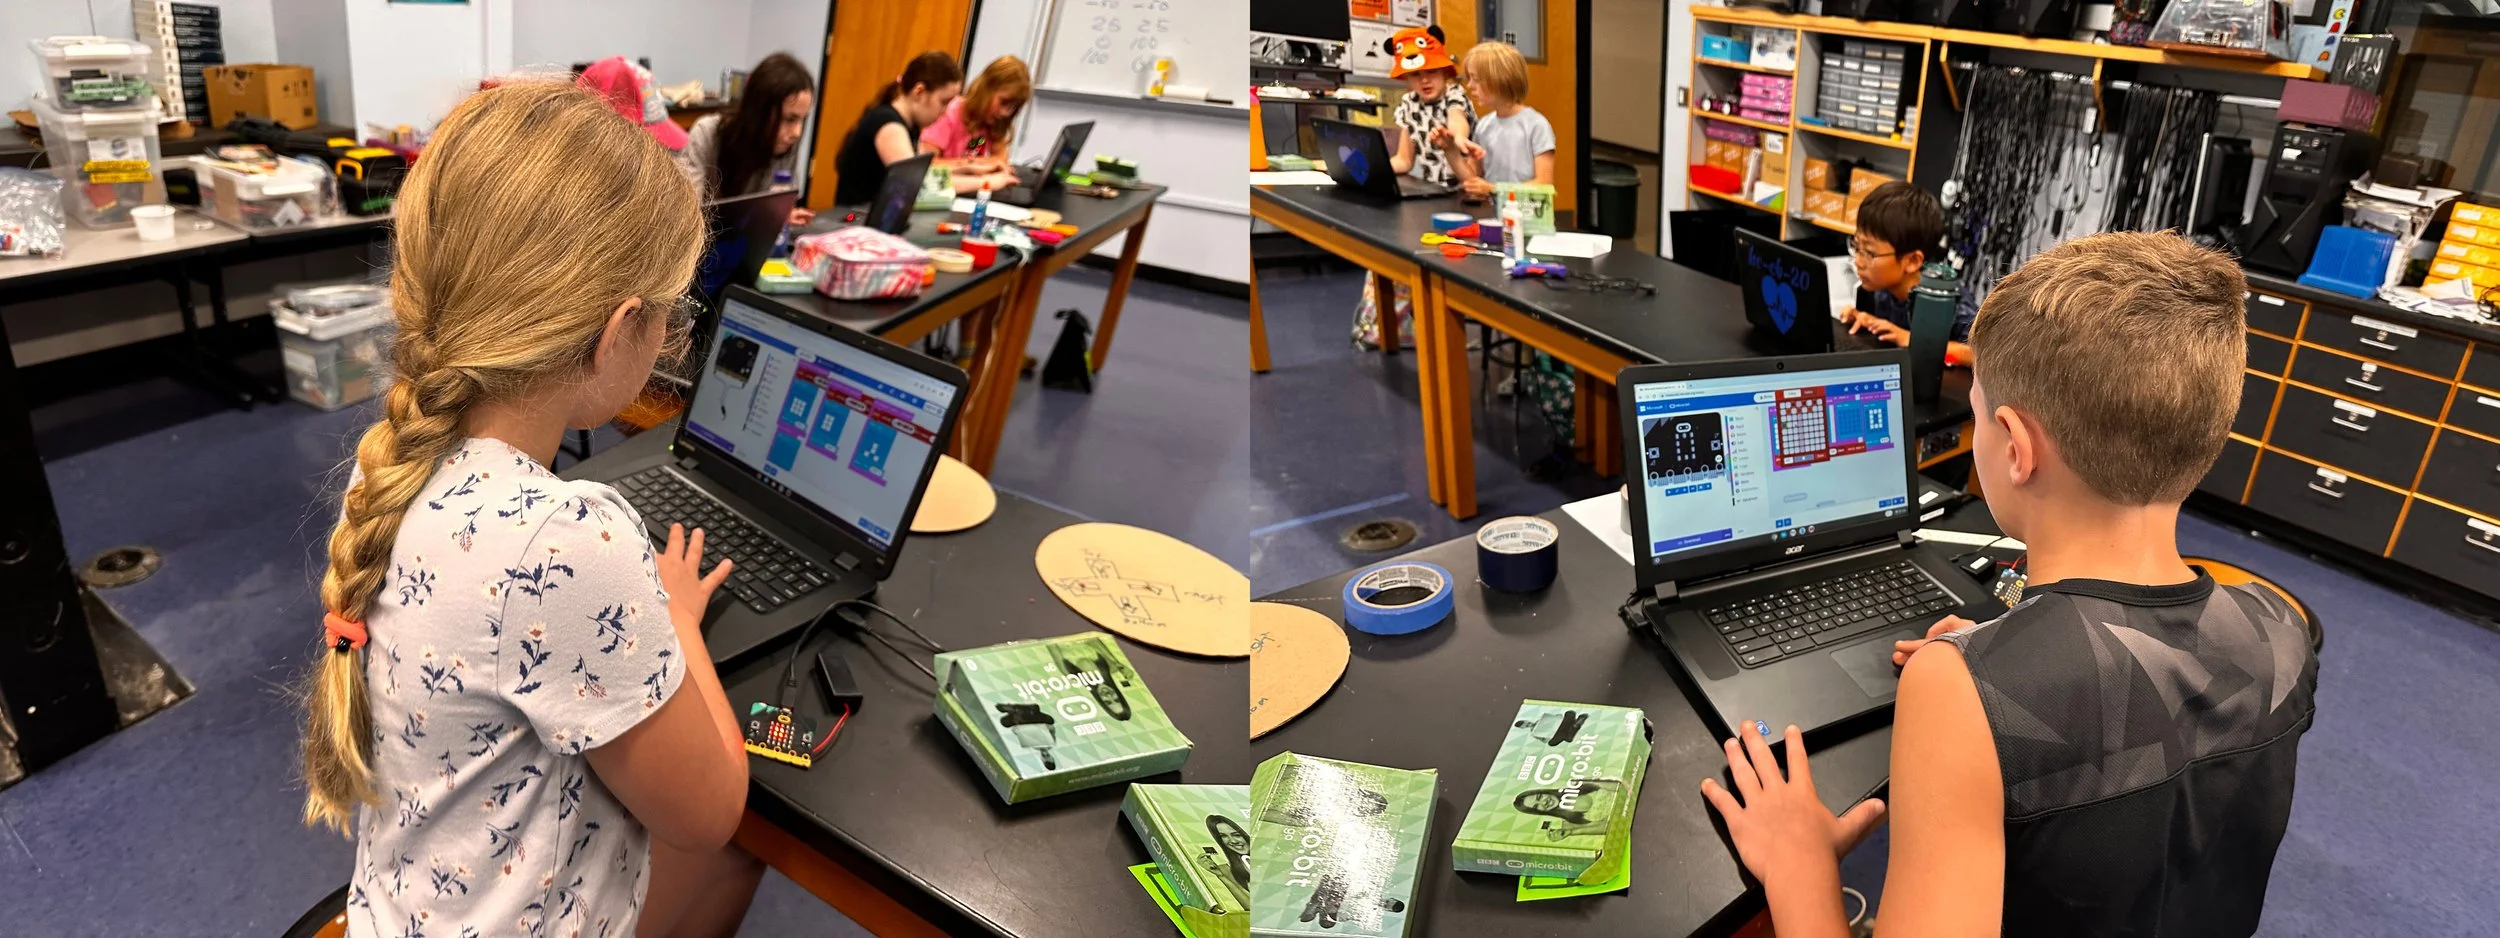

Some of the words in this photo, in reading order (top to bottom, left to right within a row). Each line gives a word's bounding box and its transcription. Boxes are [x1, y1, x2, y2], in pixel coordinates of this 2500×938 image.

[1785, 544, 1805, 555] acer
[1013, 669, 1105, 701] micro:bit
[1516, 755, 1537, 781] BBC
[1558, 733, 1600, 811] micro:bit
[1160, 850, 1191, 899] micro:bit
[1525, 860, 1574, 872] micro:bit
